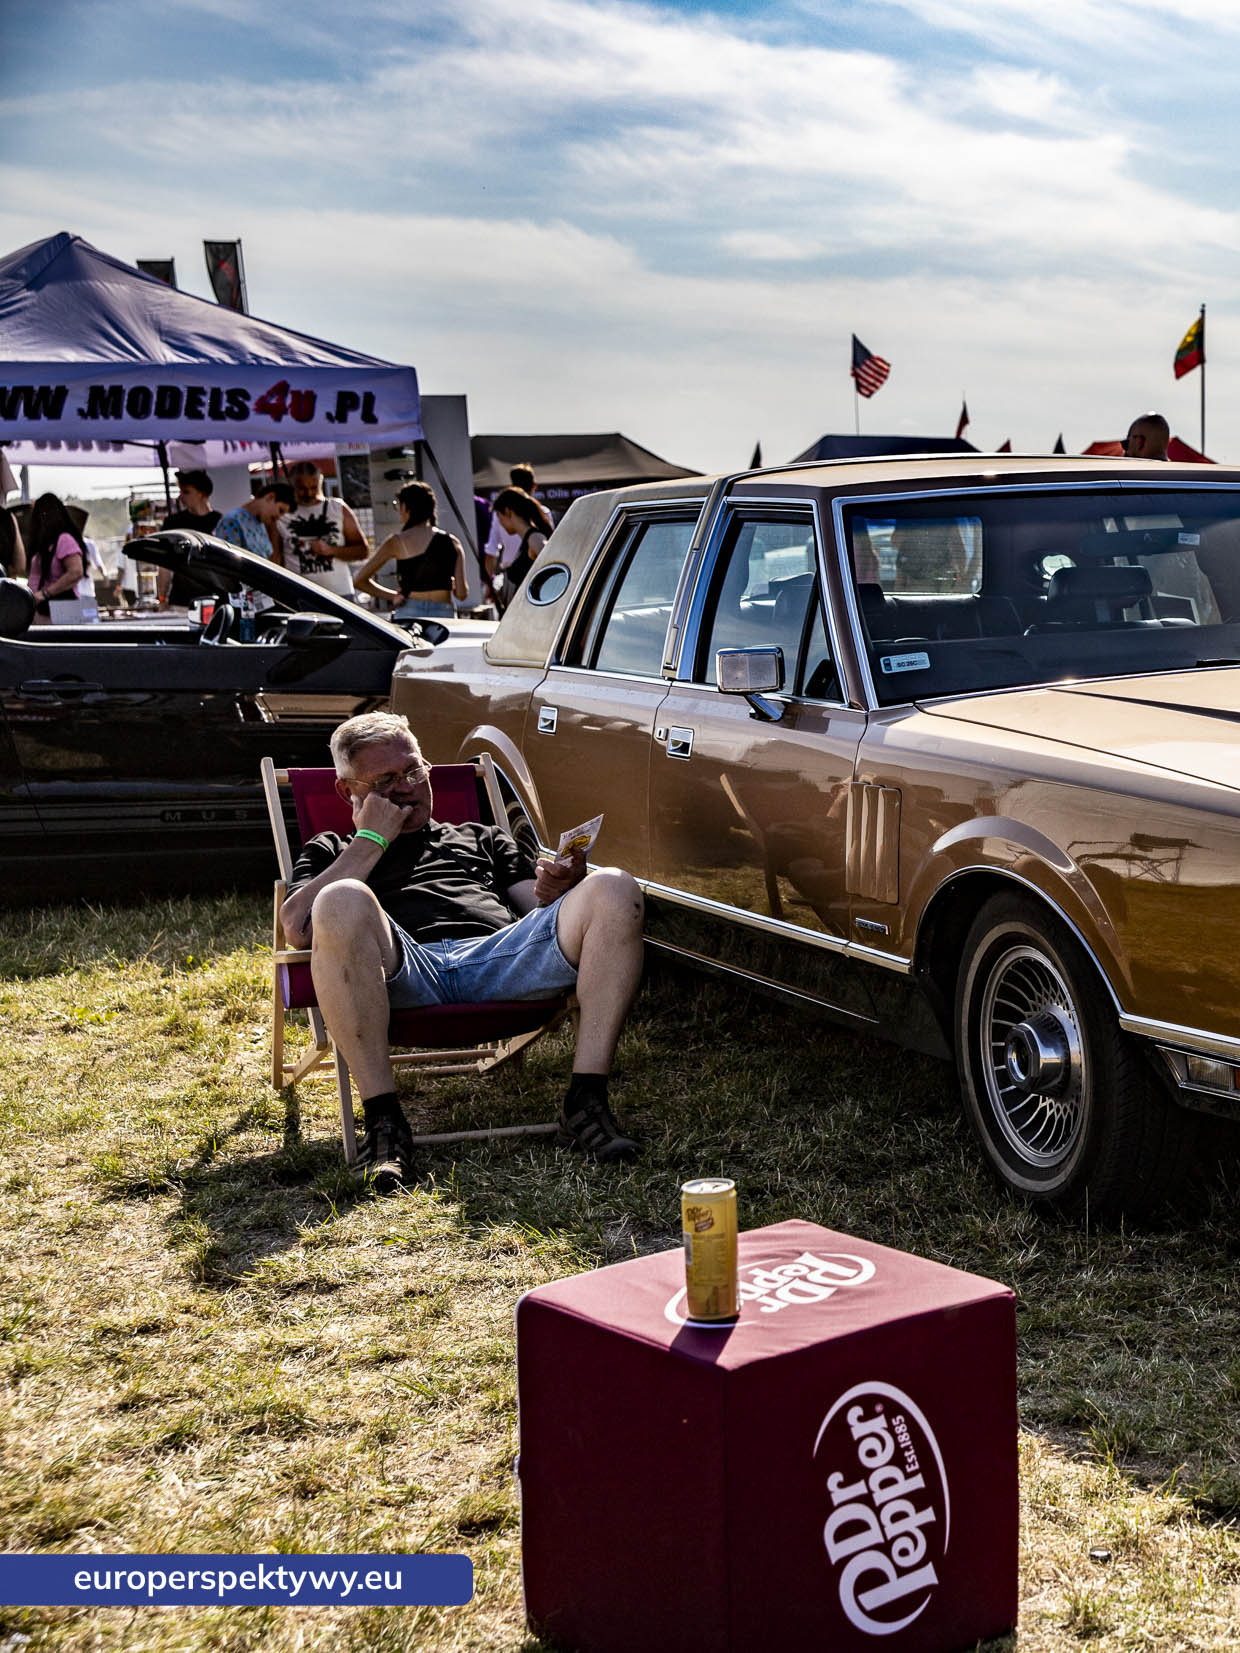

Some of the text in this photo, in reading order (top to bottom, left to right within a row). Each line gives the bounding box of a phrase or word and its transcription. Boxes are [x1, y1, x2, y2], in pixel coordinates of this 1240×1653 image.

[737, 1251, 876, 1307] Pepp
[759, 1278, 838, 1313] Dr
[824, 1471, 885, 1566] Dr
[839, 1405, 939, 1636] Pepper
